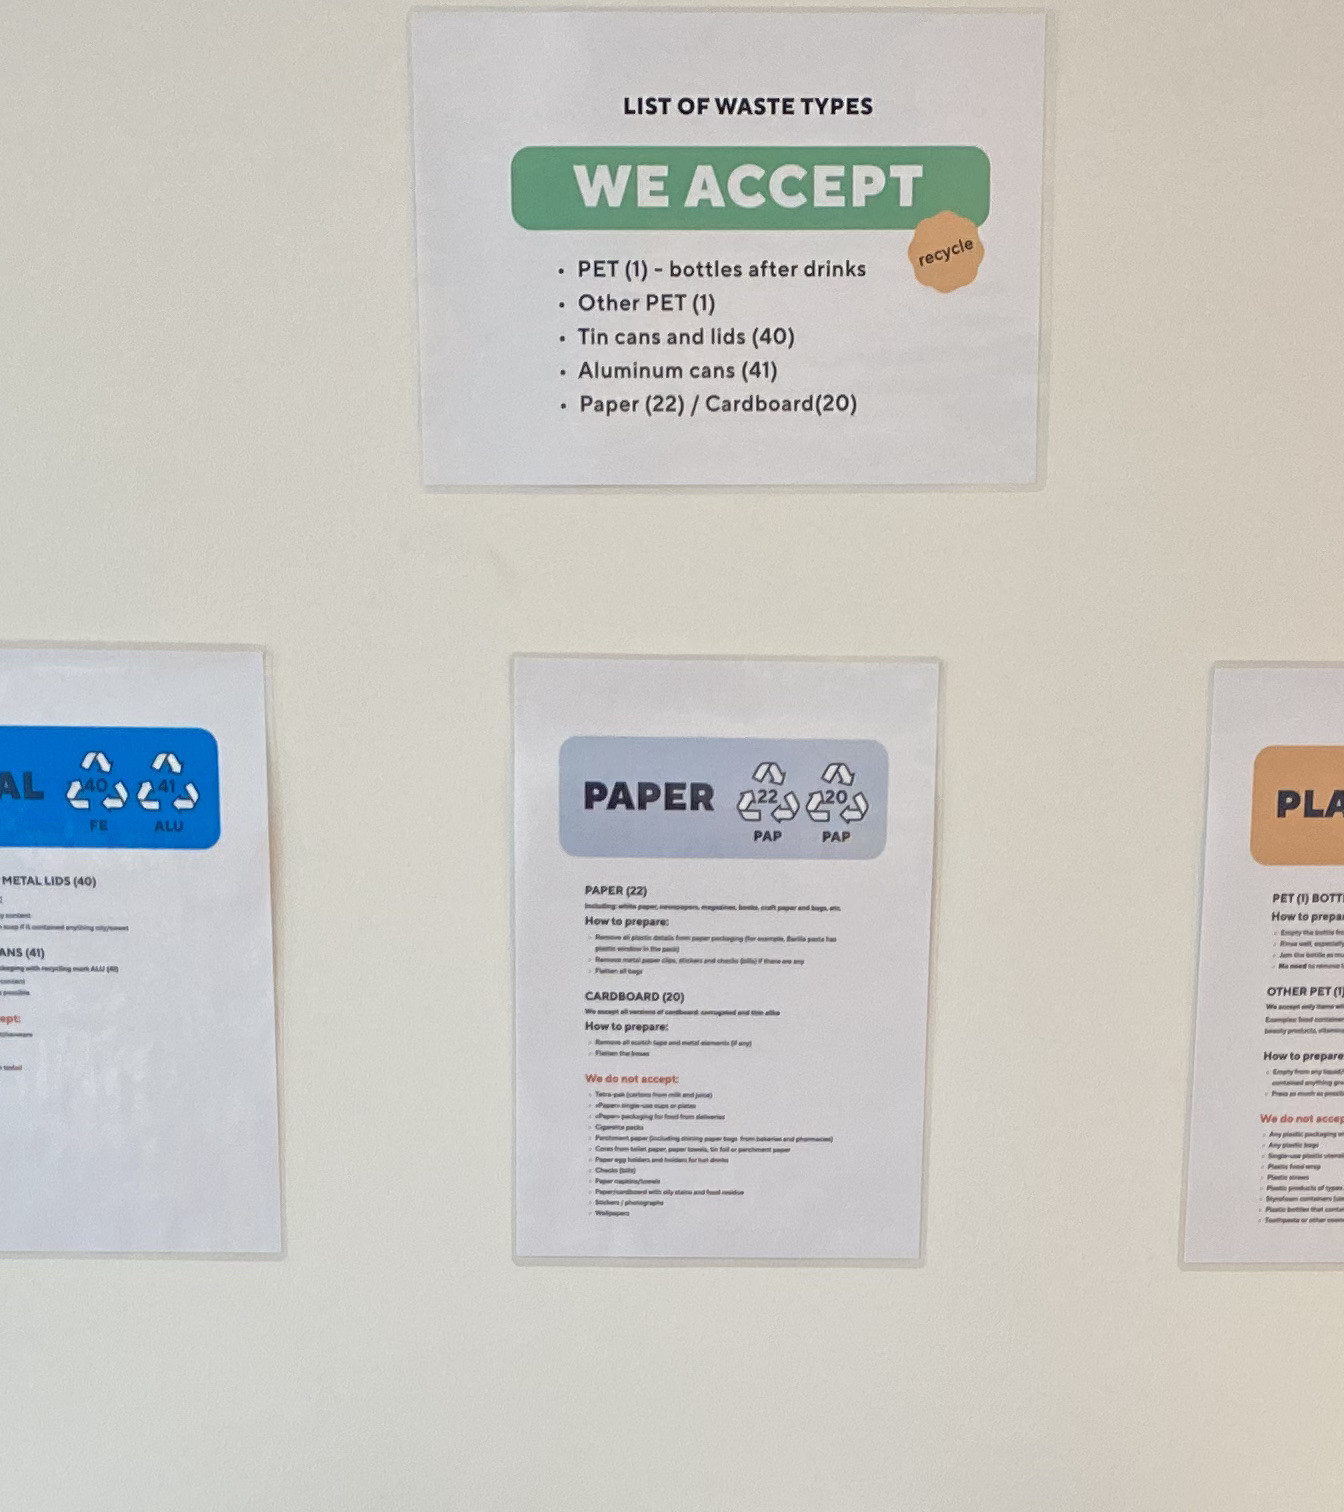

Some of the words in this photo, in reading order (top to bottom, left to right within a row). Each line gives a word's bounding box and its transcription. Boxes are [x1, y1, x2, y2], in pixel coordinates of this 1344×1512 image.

[624, 97, 672, 115] LIST
[678, 97, 710, 115] OF
[715, 98, 795, 115] WASTE
[801, 97, 873, 115] TYPES
[573, 165, 669, 207] WE
[685, 164, 923, 208] ACCEPT
[919, 239, 974, 267] recycle
[579, 260, 619, 277] PET
[626, 260, 648, 282] (1)
[670, 260, 742, 277] bottles
[749, 260, 798, 277] after
[804, 260, 866, 277] drinks
[579, 294, 640, 311] Other
[647, 294, 687, 311] PET
[693, 294, 715, 316] (1)
[578, 328, 608, 345] Tin
[615, 332, 660, 345] cans
[667, 328, 704, 345] and
[711, 328, 745, 345] lids
[752, 327, 794, 349] (40)
[579, 362, 683, 379] Aluminum
[690, 366, 735, 379] cans
[742, 361, 777, 383] (41)
[581, 395, 639, 416] Paper
[646, 395, 684, 417] (22)
[691, 395, 699, 416] /
[706, 394, 857, 416] Cardboard(20)
[84, 779, 108, 793] 40
[158, 779, 175, 793] 41
[585, 781, 715, 811] PAPER
[757, 789, 778, 803] 22
[825, 789, 848, 803] 20
[89, 820, 108, 831] FE
[155, 820, 184, 832] ALU
[753, 830, 782, 842] PAP
[822, 831, 851, 843] PAP
[2, 876, 42, 886] METAL
[45, 876, 71, 886] LIDS
[74, 876, 96, 888] (40)
[585, 886, 623, 895] PAPER
[626, 886, 647, 898] (22)
[1273, 893, 1295, 903] PET
[1297, 893, 1309, 905] (1)
[585, 916, 610, 925] How
[625, 919, 669, 928] prepare:
[1272, 911, 1296, 921] How
[1298, 913, 1309, 921] to
[26, 948, 45, 960] (41)
[1267, 987, 1307, 996] OTHER
[1310, 986, 1332, 996] PET
[585, 991, 660, 1001] CARDBOARD
[663, 992, 684, 1004] (20)
[585, 1021, 609, 1031] How
[611, 1023, 622, 1031] to
[624, 1024, 669, 1033] prepare:
[1264, 1051, 1288, 1060] How
[1290, 1052, 1301, 1061] to
[585, 1074, 603, 1083] We
[605, 1074, 619, 1083] do
[621, 1075, 639, 1083] not
[641, 1075, 679, 1086] accept:
[1260, 1114, 1278, 1123] We
[1280, 1114, 1294, 1123] do
[1296, 1115, 1314, 1123] not
